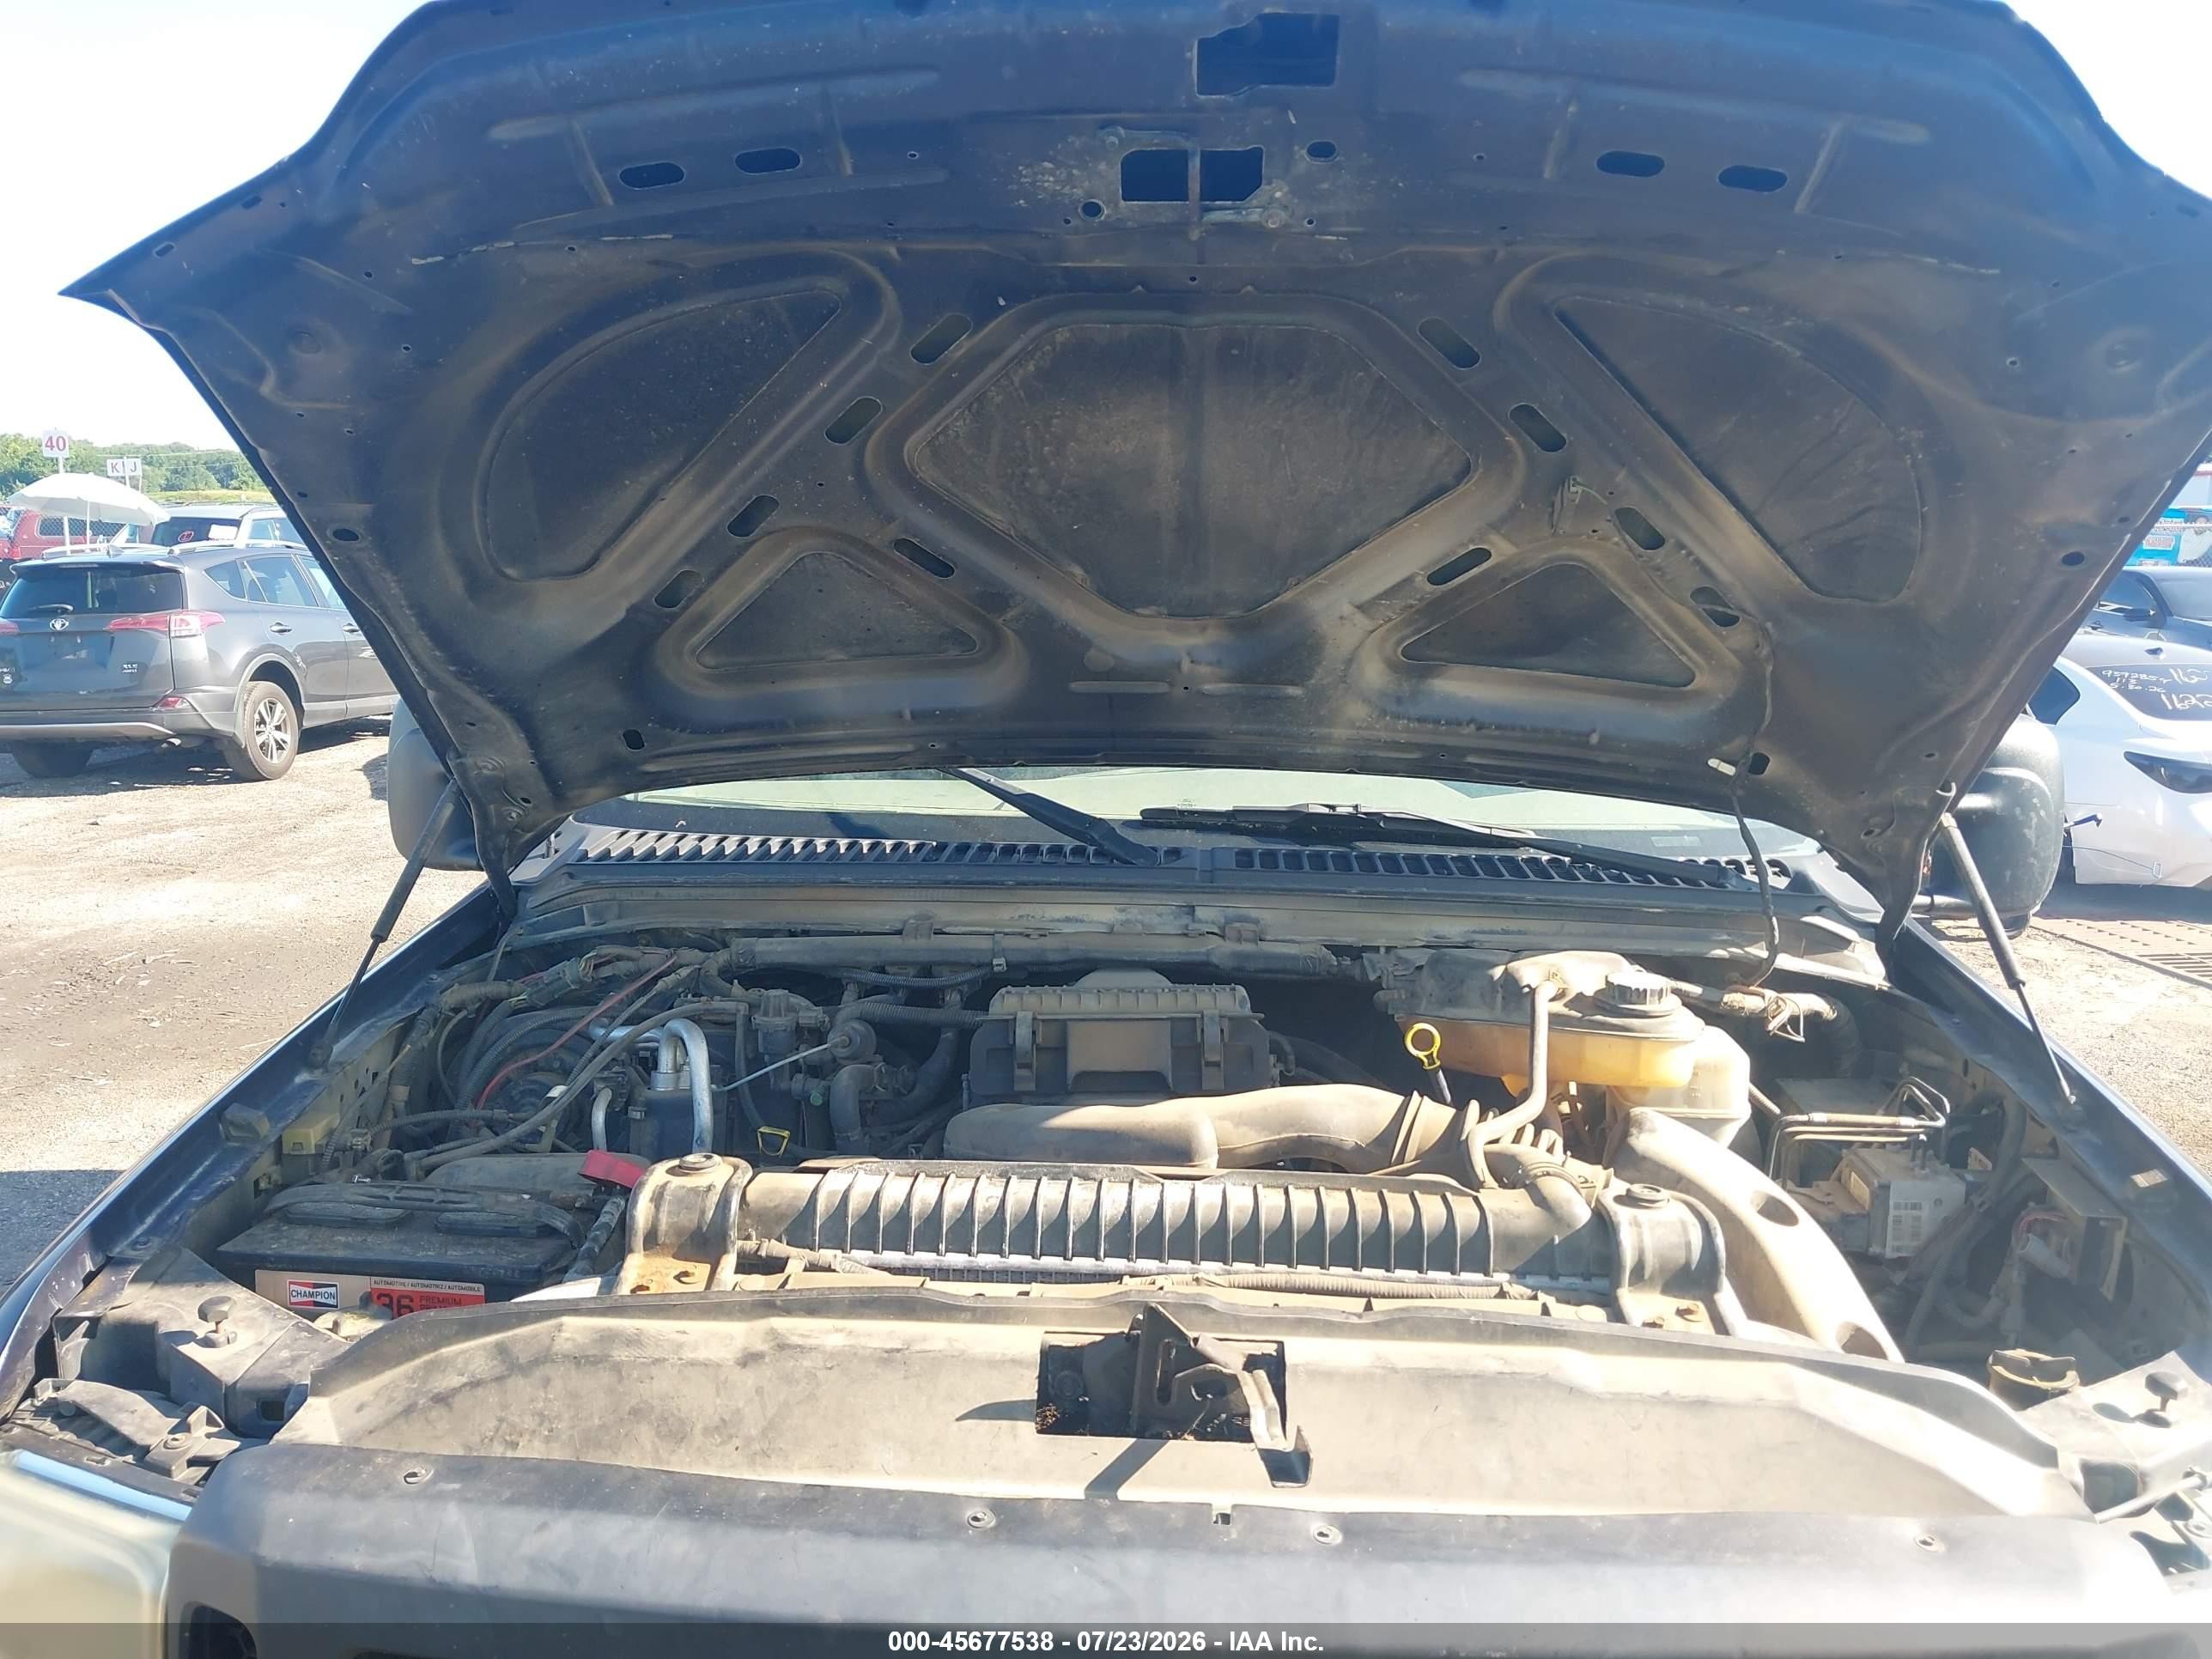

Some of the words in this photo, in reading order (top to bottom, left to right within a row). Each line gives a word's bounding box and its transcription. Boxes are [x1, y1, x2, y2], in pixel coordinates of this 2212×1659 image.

[45, 435, 66, 452] 40
[111, 462, 120, 473] K
[131, 460, 137, 472] J
[374, 1279, 406, 1288] AUTOMOTIVE
[447, 1284, 481, 1292] AUTOMOBILE
[290, 1289, 336, 1300] CHAMPION
[419, 1295, 463, 1306] PREMIUM
